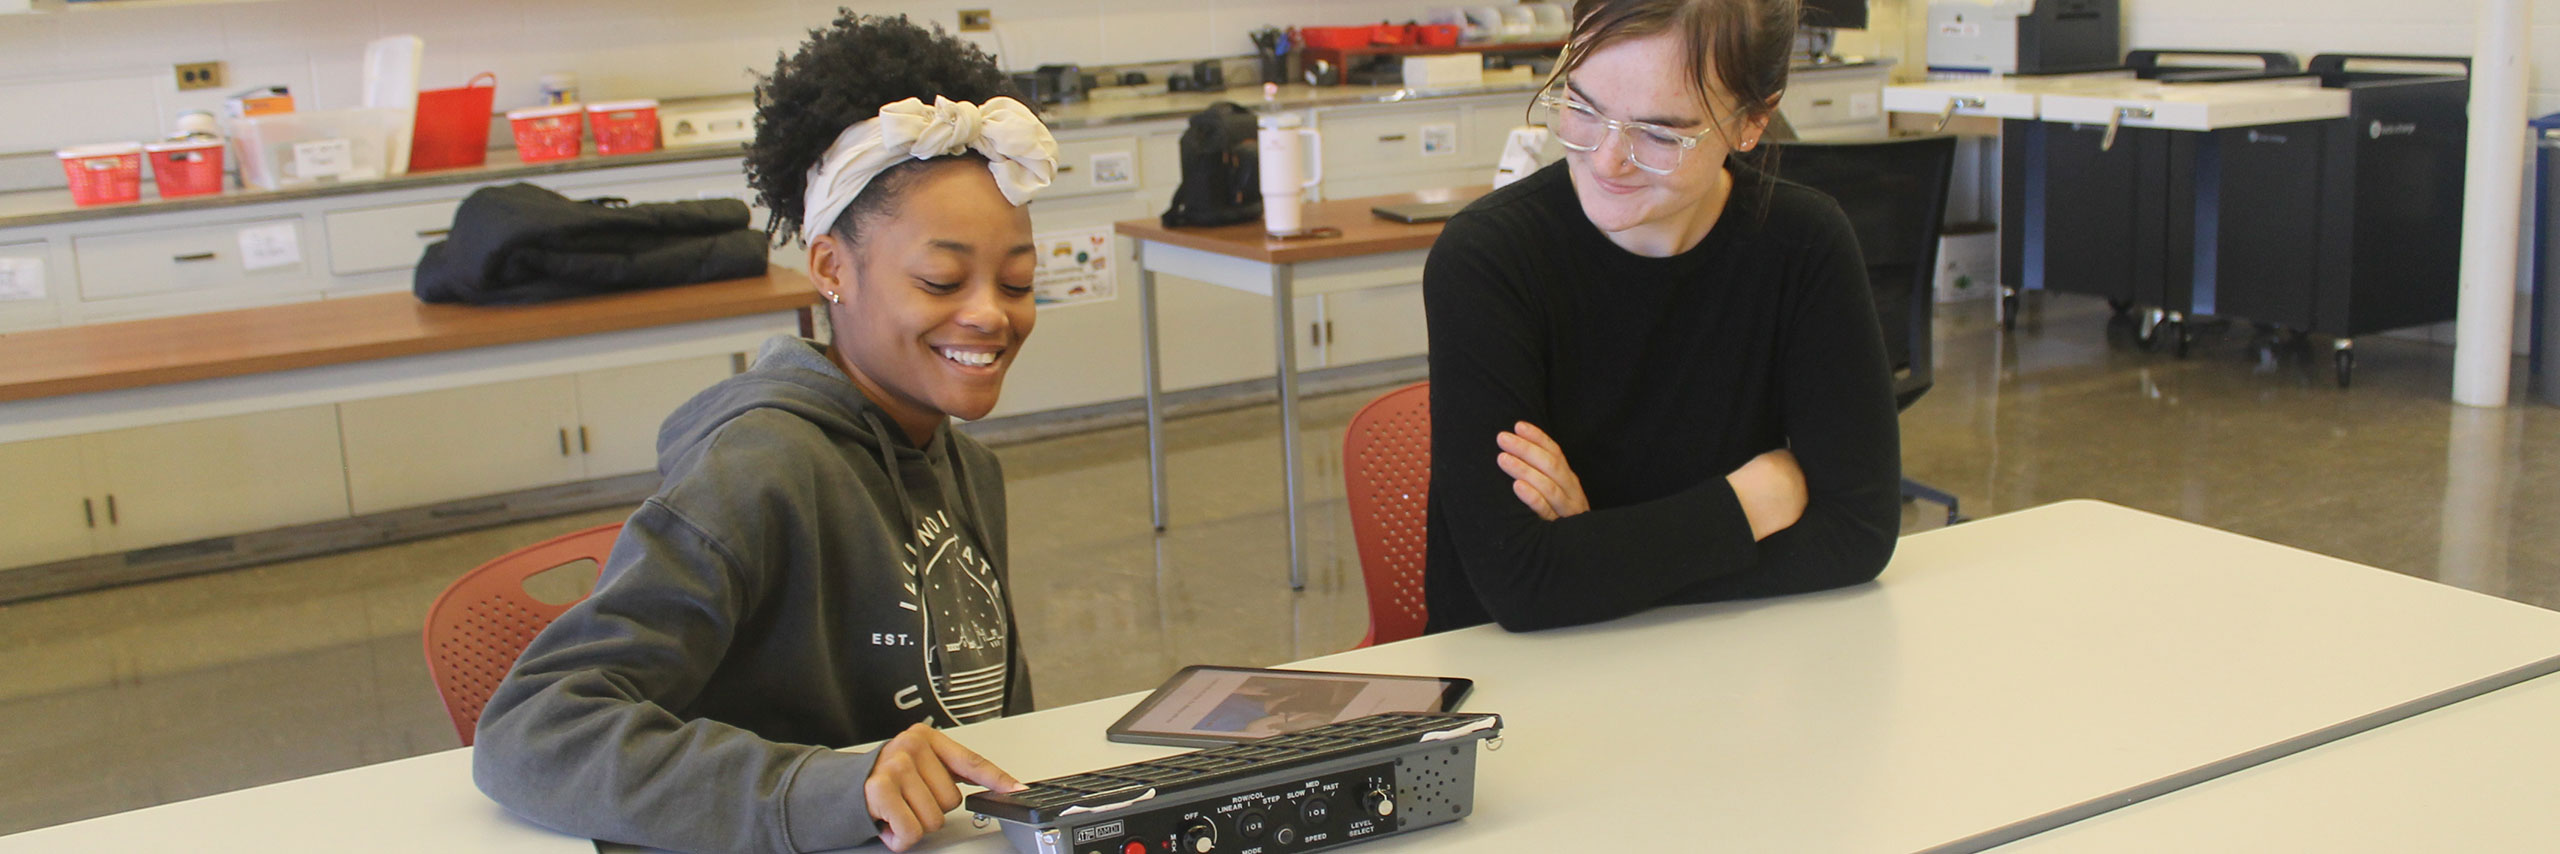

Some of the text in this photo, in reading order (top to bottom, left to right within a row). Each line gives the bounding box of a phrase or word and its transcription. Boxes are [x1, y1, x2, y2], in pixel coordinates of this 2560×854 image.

[899, 510, 950, 611] ILLINOI
[872, 633, 914, 646] EST.
[1305, 780, 1320, 788] MED
[1323, 782, 1339, 791] FAST
[1286, 789, 1306, 799] SLOW
[1262, 795, 1280, 804] STEP
[1217, 803, 1243, 814] LINEAR
[1184, 812, 1199, 820] OFF
[1350, 820, 1373, 829] LEVEL
[1348, 826, 1375, 837] SELECT
[1304, 833, 1327, 843] SPEED
